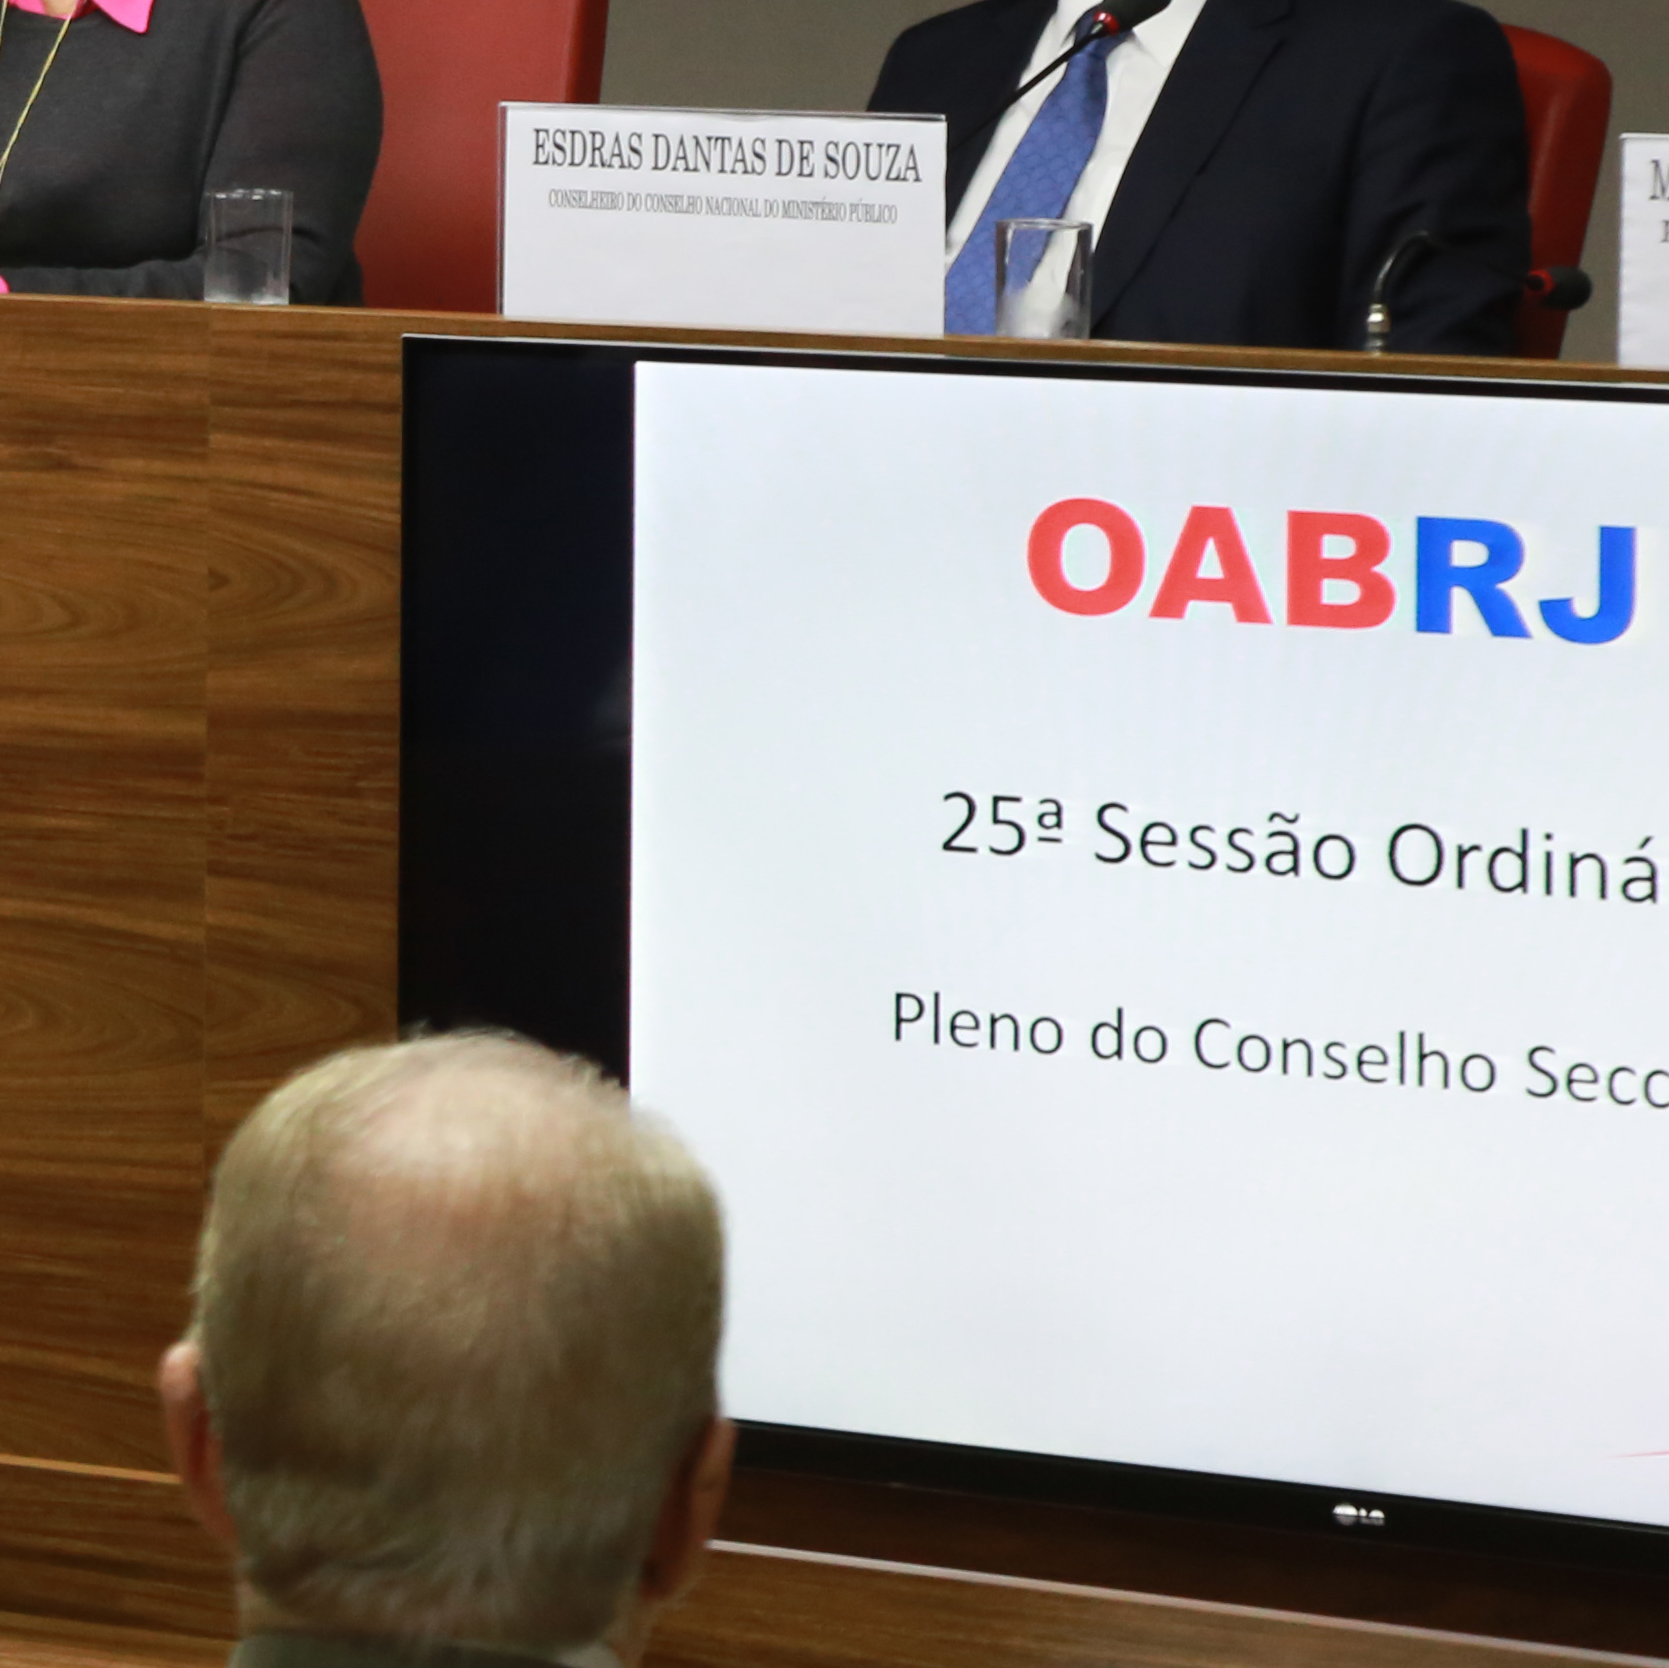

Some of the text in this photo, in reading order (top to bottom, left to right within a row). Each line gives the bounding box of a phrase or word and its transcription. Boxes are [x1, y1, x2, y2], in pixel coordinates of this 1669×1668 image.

[532, 128, 923, 182] ESDRAS DANTAS DE SOUZA
[549, 188, 898, 224] CONSELHEIRO DO CONSELHO NACIONAL DO MINISTÉRIO PÚBLICO
[1026, 497, 1637, 645] OABRJ
[941, 791, 1659, 905] 25ª Sessão Ordiná
[893, 991, 1064, 1056] Pleno
[1090, 1007, 1169, 1065] do
[1194, 1018, 1497, 1093] Conselho
